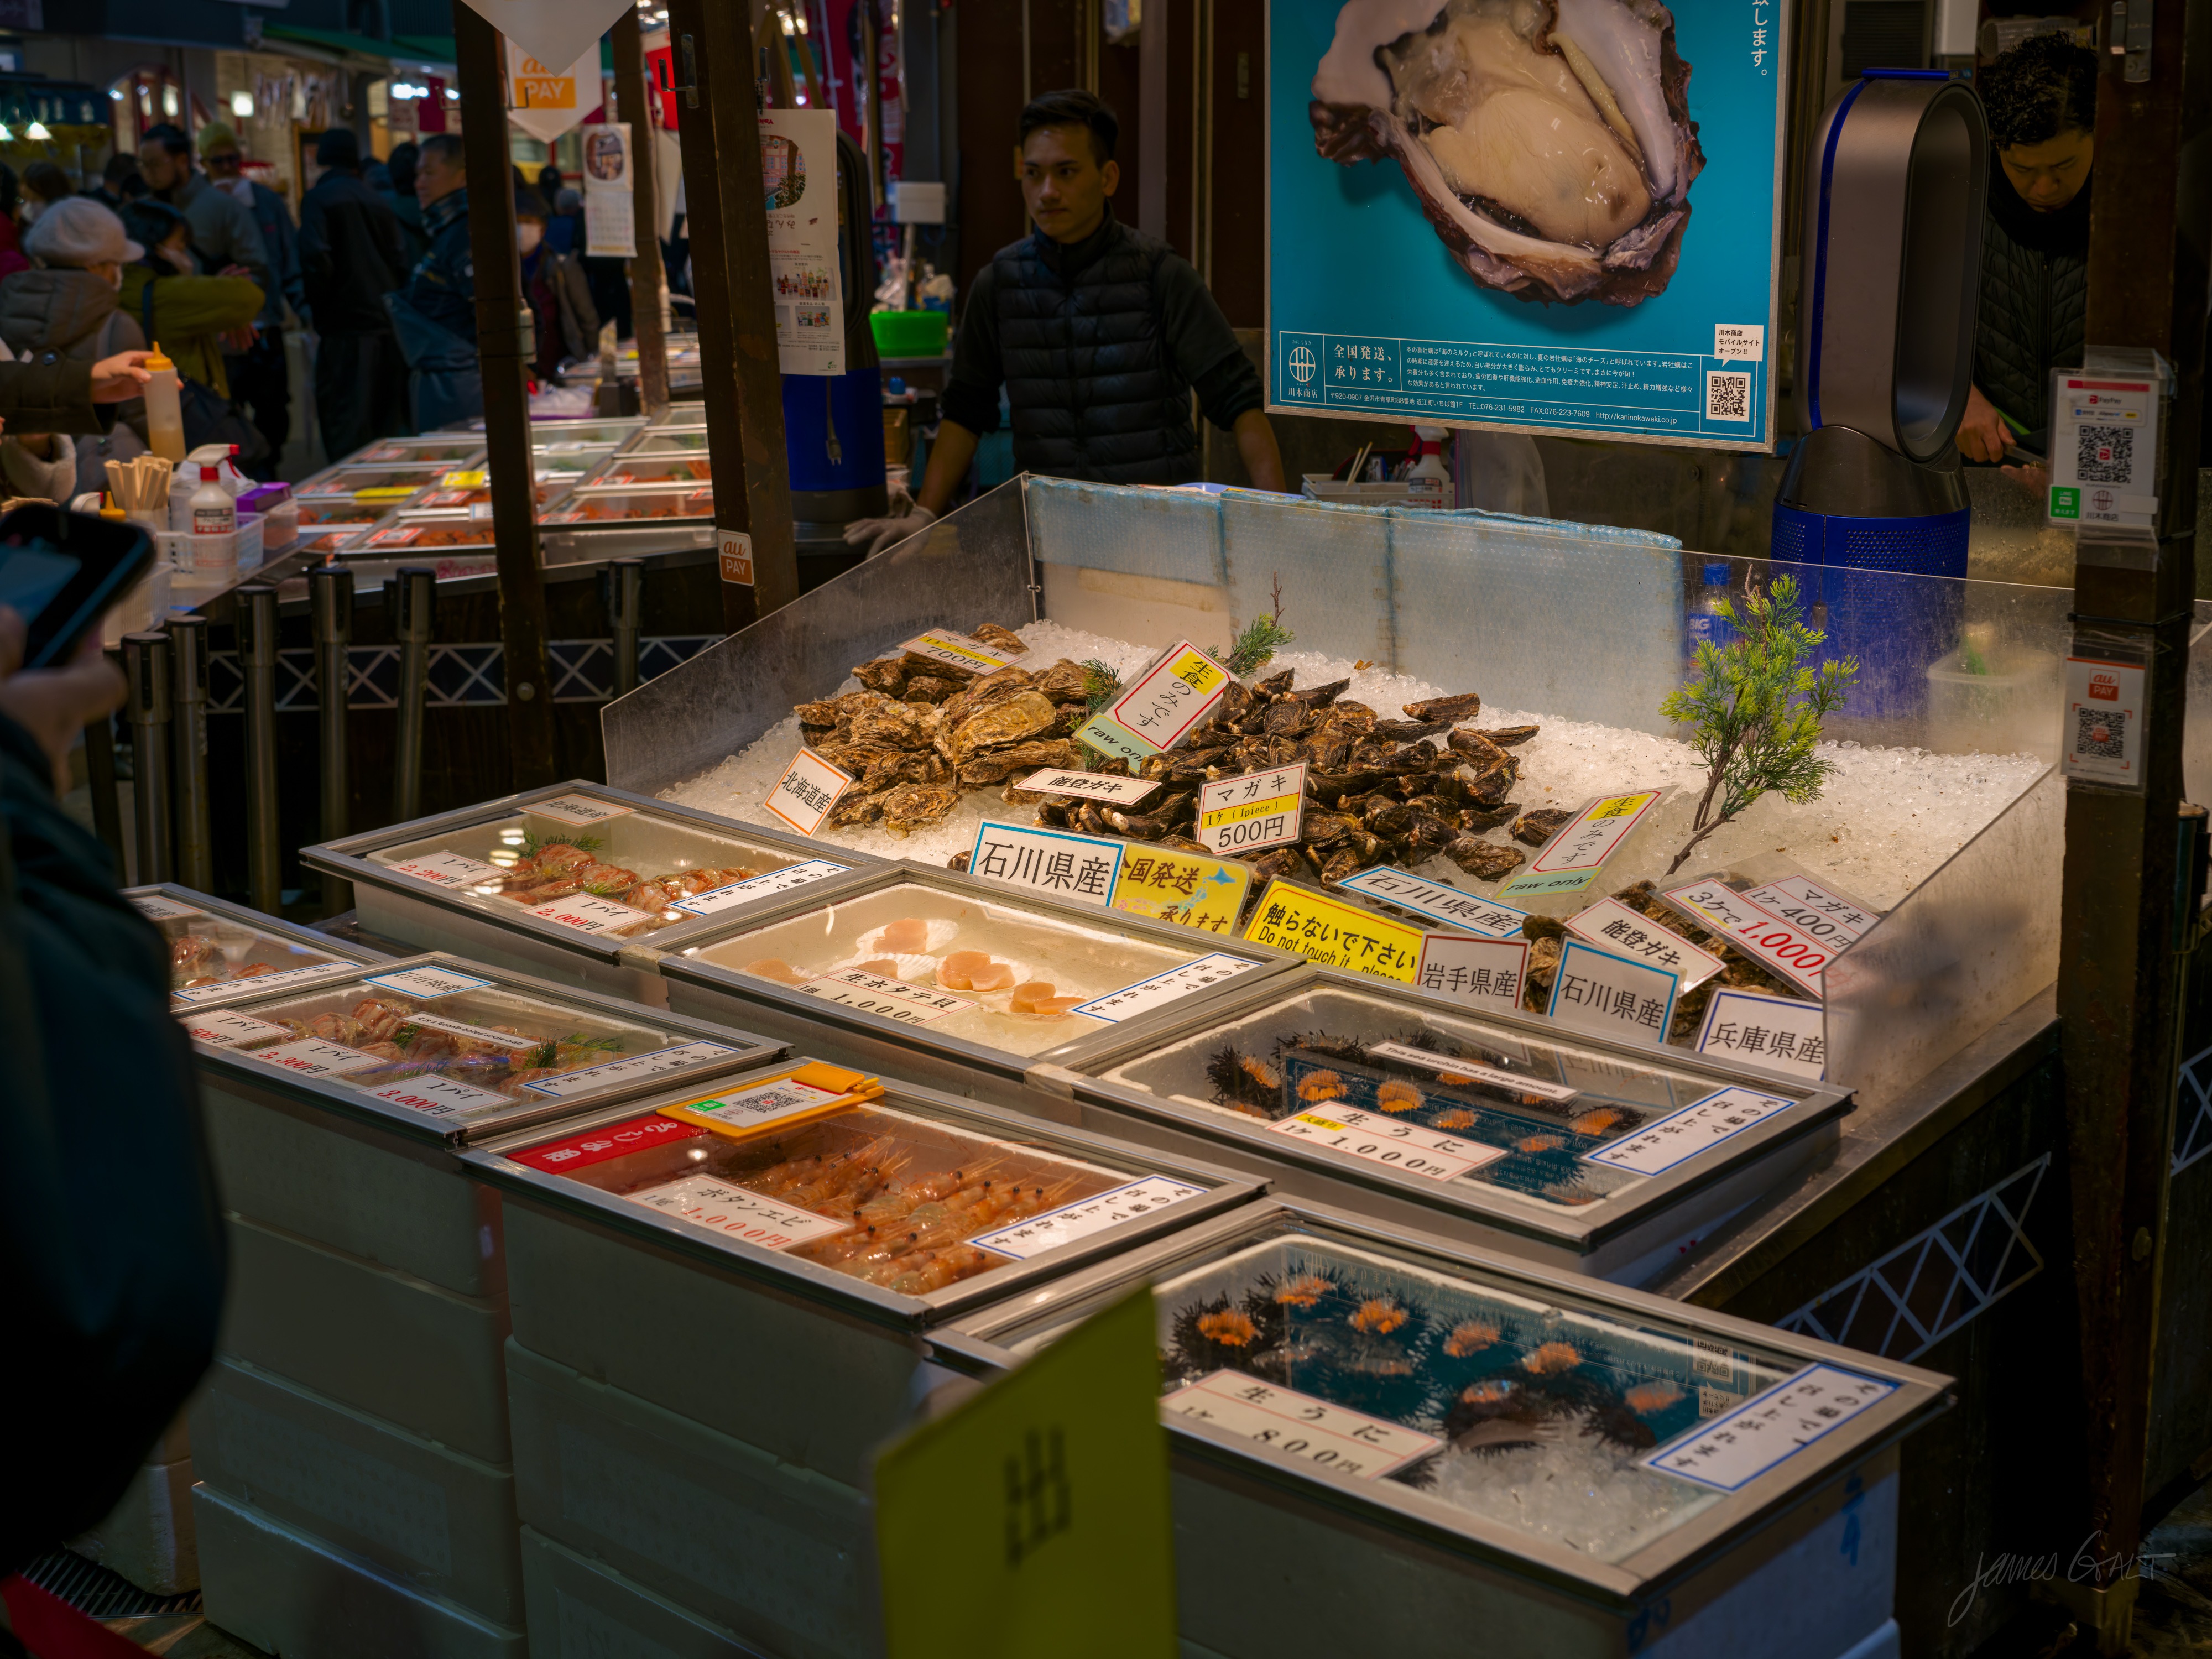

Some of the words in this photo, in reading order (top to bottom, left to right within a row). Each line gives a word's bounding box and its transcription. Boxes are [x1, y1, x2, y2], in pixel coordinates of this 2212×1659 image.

[524, 80, 565, 100] PAY
[1334, 343, 1392, 361] 全国発送、
[1719, 338, 1760, 347] モバイルサイト
[1334, 365, 1392, 383] 承ります。
[1407, 380, 1486, 392] な効果があると言われています。
[1288, 387, 1318, 398] 川木商店
[2099, 397, 2122, 405] PayPay
[1364, 395, 1415, 405] 金沢市青草町88番地
[1416, 398, 1463, 409] 近江町いちば館1F
[1469, 402, 1525, 413] TEL:076-231-5982
[1530, 407, 1590, 418] FAX:076-223-7609
[1596, 411, 1677, 425] http://kaninokawaki.co.jp
[2086, 512, 2119, 521] 川木商店
[724, 541, 746, 556] au
[726, 559, 745, 575] PAY
[927, 645, 987, 670] 700円
[943, 635, 1003, 658] マガキ
[2093, 674, 2116, 684] au
[2094, 685, 2114, 696] PAY
[1137, 661, 1213, 727] 生食のみです
[1087, 726, 1120, 744] raw
[782, 770, 831, 815] 北海道産
[1047, 775, 1123, 794] 能登ガキ
[1217, 774, 1287, 802] マガキ
[545, 801, 610, 819] 北海道産
[1218, 816, 1285, 848] 500円
[1562, 797, 1634, 865] 生食のみです
[399, 864, 462, 885] 2,200円
[441, 858, 487, 873] 1パイ
[978, 841, 1110, 896] 石川県産
[684, 868, 808, 906] 召し上がれます
[1507, 880, 1541, 894] raw
[1547, 874, 1591, 890] only
[580, 901, 629, 917] 1パイ
[1364, 872, 1525, 932] 石川県産
[1688, 890, 1743, 925] 3ケで
[1804, 888, 1864, 925] マガキ
[535, 907, 604, 930] 2,000円
[1159, 906, 1228, 935] 承ります
[1750, 889, 1781, 905] 1ケ
[1784, 903, 1853, 948] 400円
[1258, 926, 1275, 943] Do
[1277, 935, 1300, 952] not
[1302, 942, 1337, 966] touch
[1263, 902, 1416, 968] 触らないで下さい
[1601, 919, 1682, 967] 能登ガキ
[394, 972, 465, 992] 石川県産
[841, 973, 957, 1008] 生ホタテ貝
[1087, 964, 1212, 1012] 召し上がれます
[1423, 964, 1518, 1000] 岩手県産
[831, 993, 925, 1024] 1,000円
[1560, 974, 1664, 1029] 石川県産
[216, 1016, 266, 1031] 1パイ
[436, 1021, 461, 1031] female
[308, 1045, 361, 1061] 1パイ
[1710, 1022, 1824, 1065] 兵庫県産
[258, 1051, 330, 1074] 3,300円
[540, 1048, 691, 1088] 召し上がれます
[1386, 1047, 1406, 1055] This
[1426, 1057, 1459, 1070] urchin
[1488, 1073, 1515, 1084] large
[377, 1088, 456, 1115] 3,000円
[427, 1082, 484, 1100] 1パイ
[1337, 1112, 1464, 1152] 生うに
[1607, 1099, 1734, 1161] 召し上がれます
[697, 1187, 811, 1228] ボタンエビ
[989, 1189, 1147, 1245] 召し上がれます
[682, 1206, 792, 1248] 1,000円
[1234, 1385, 1391, 1443] 生うに
[1674, 1384, 1824, 1467] 召し上がれます
[1252, 1428, 1364, 1474] 800円
